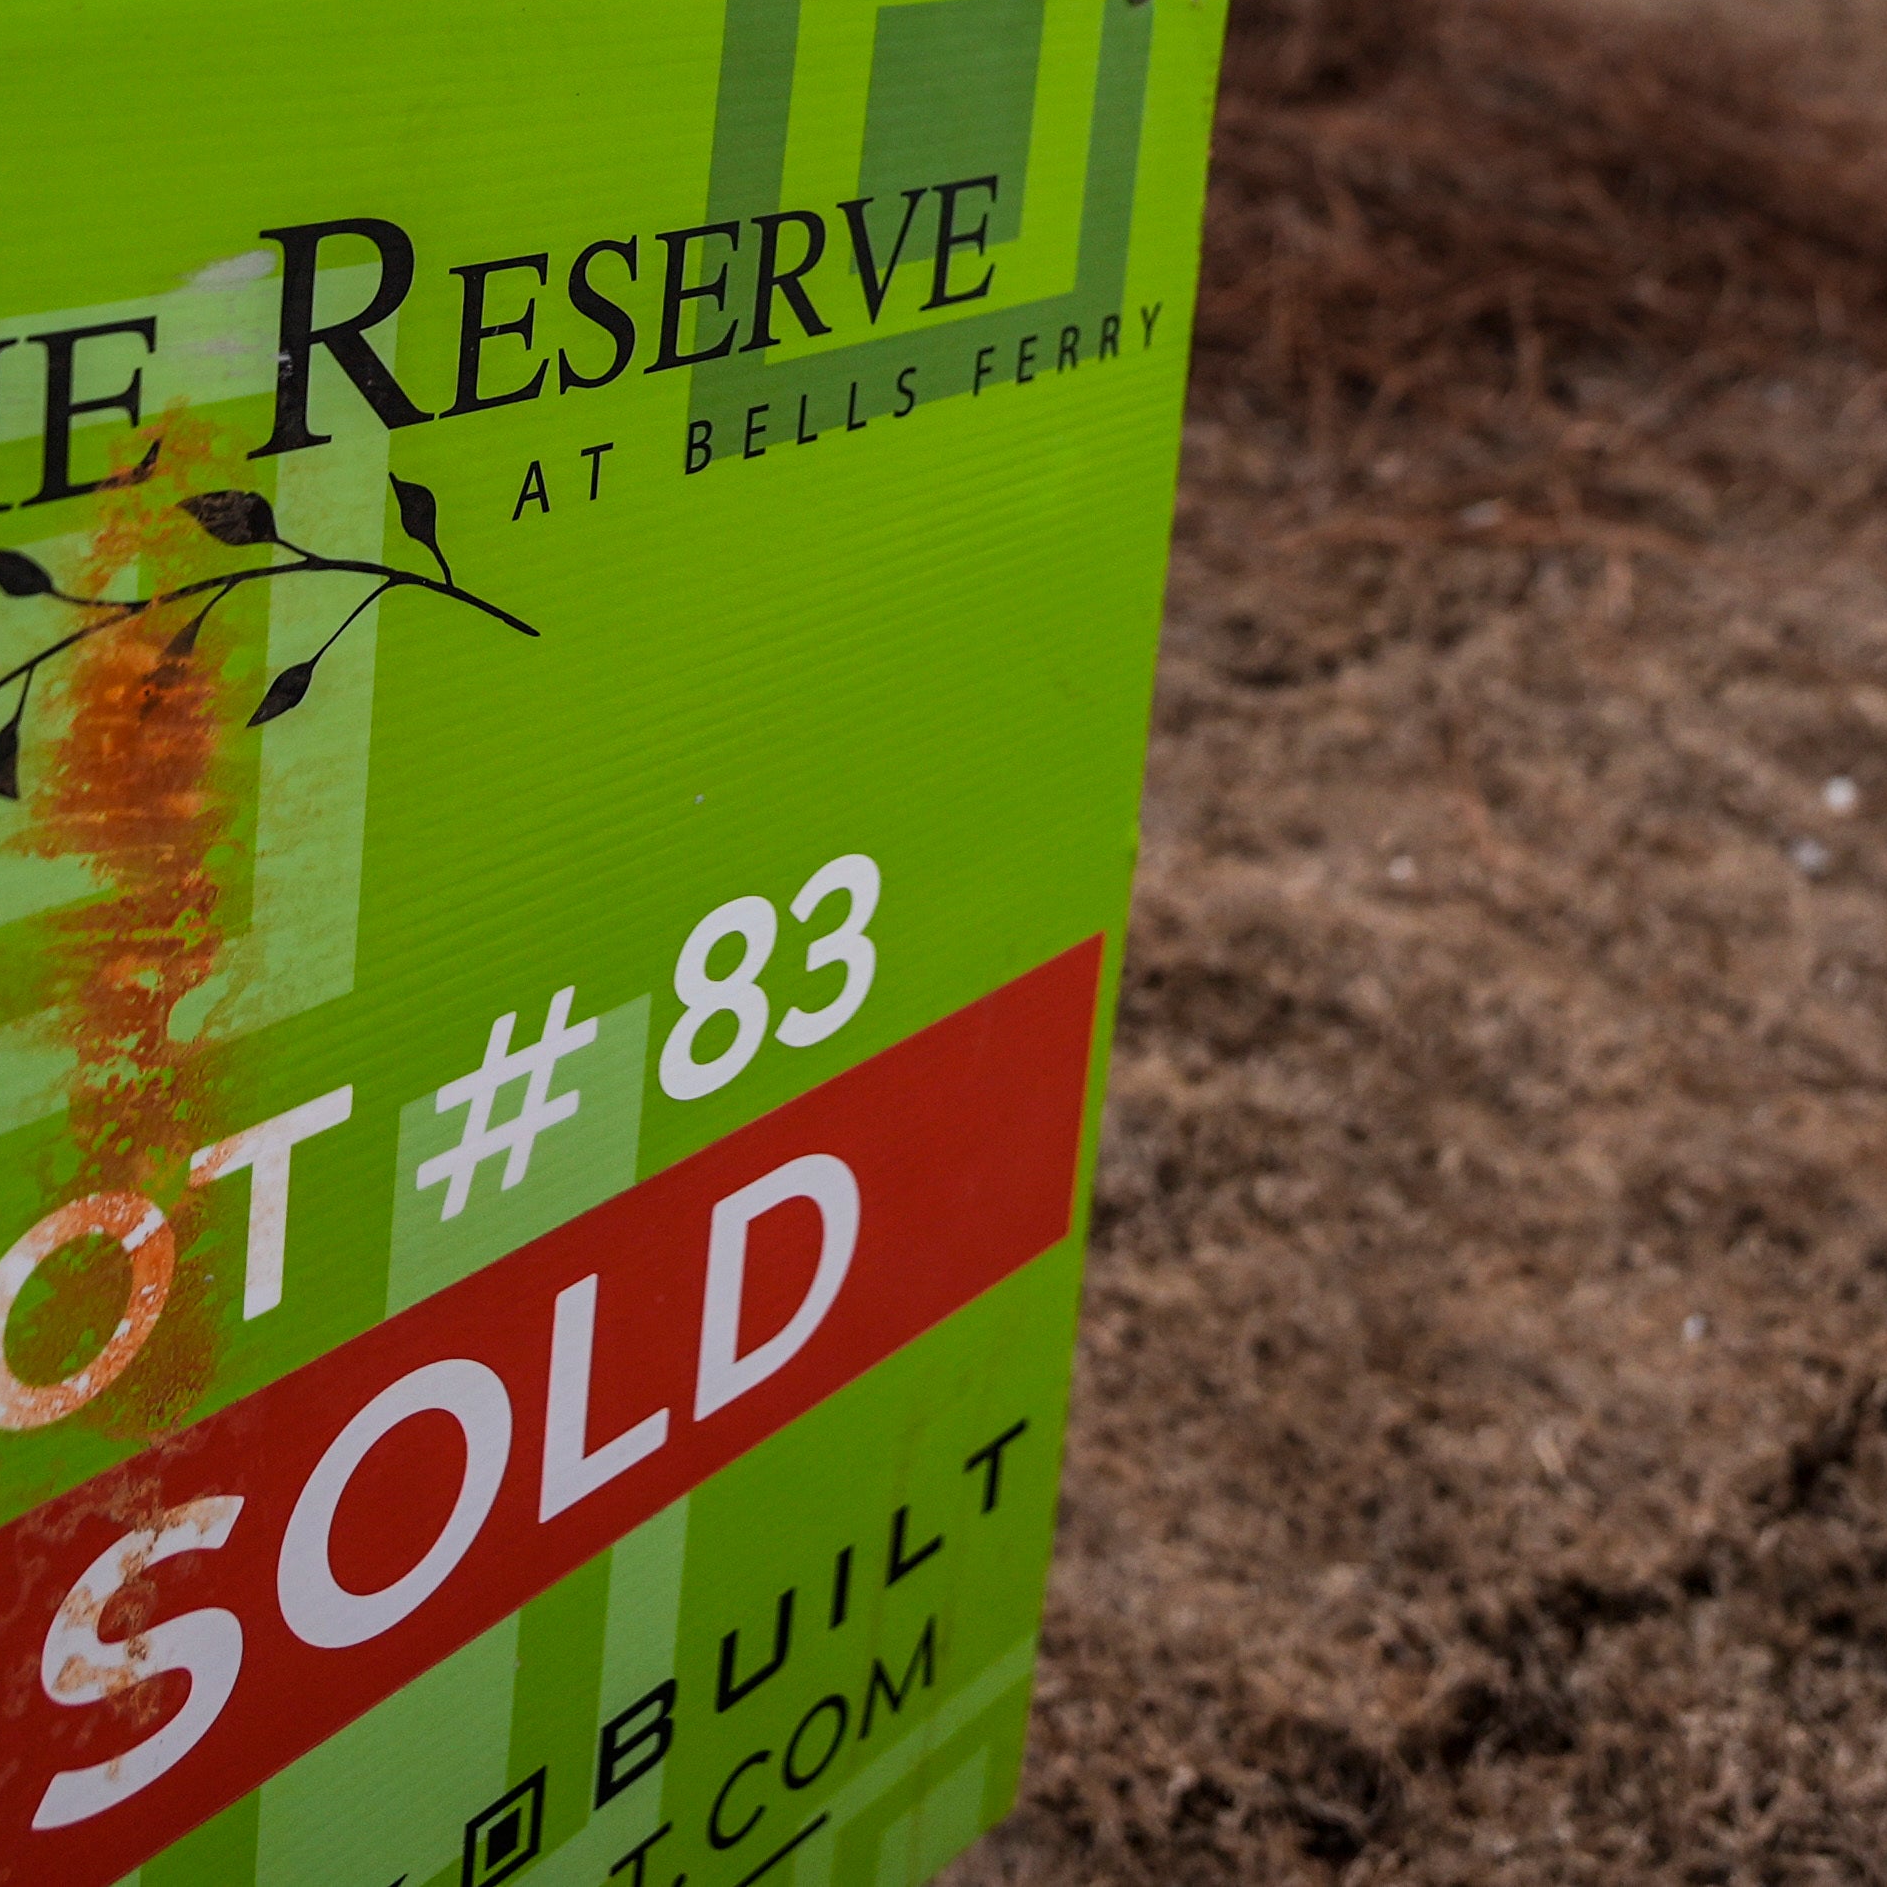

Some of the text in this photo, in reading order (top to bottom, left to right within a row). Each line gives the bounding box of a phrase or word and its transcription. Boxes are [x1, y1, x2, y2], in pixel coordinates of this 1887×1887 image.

[250, 177, 1000, 456] RESERVE
[513, 303, 1166, 520] AT BELLS FERRY
[417, 987, 597, 1216] #
[660, 854, 880, 1101] 83
[33, 1154, 858, 1830] SOLD
